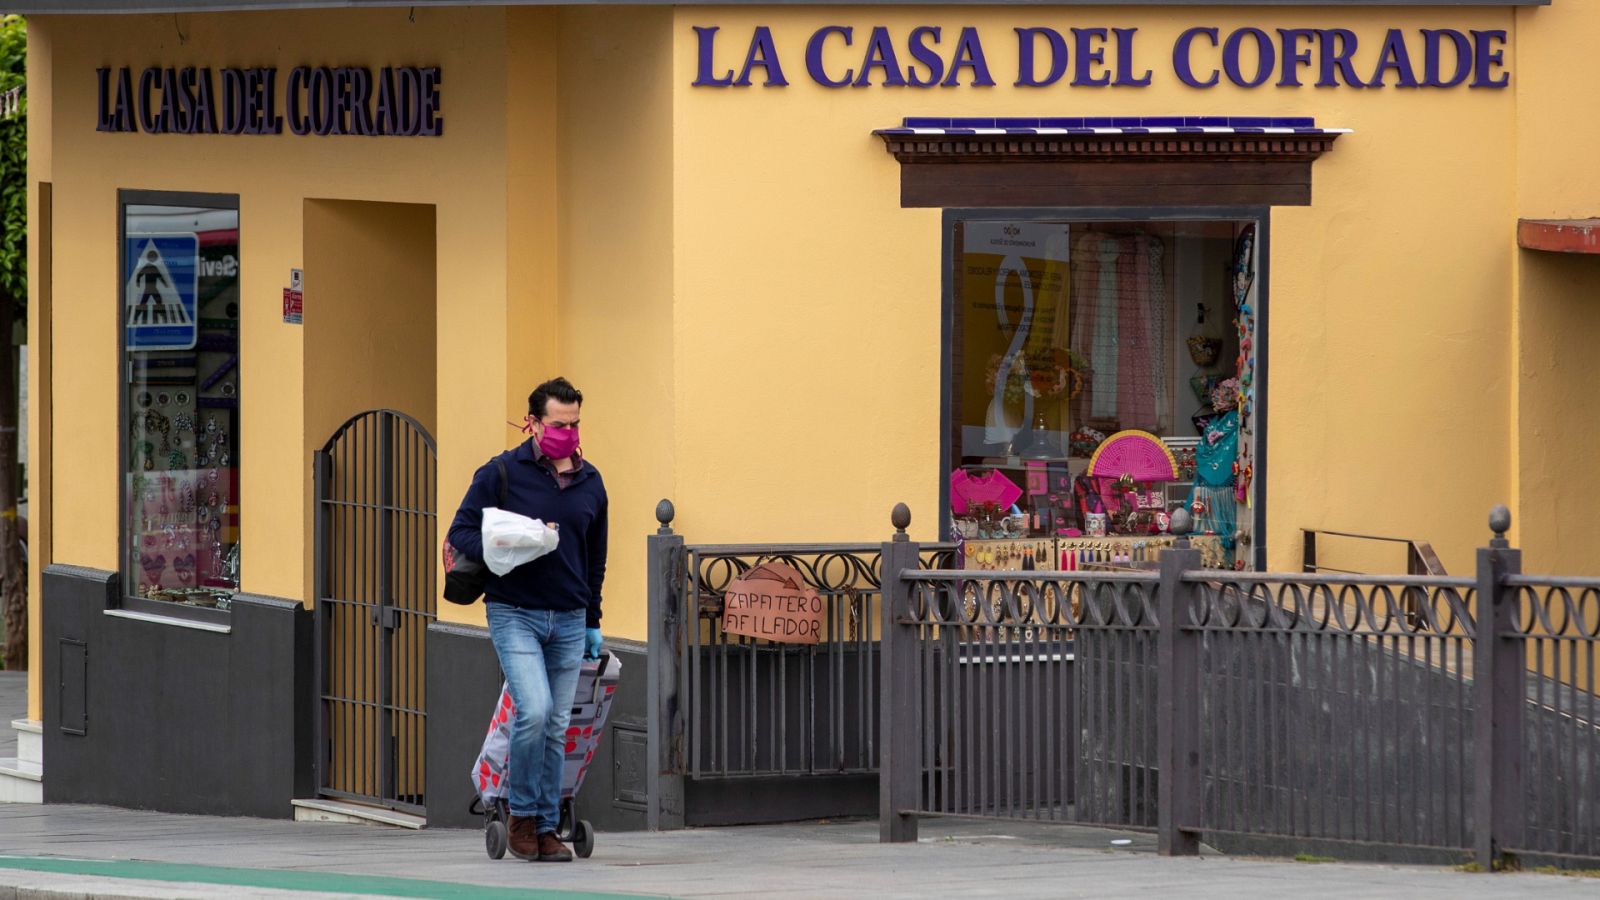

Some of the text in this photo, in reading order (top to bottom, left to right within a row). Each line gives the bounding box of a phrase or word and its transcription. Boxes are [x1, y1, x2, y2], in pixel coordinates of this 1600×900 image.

[691, 25, 1510, 89] LA CASA DEL COFRADE
[96, 66, 443, 136] LA CASA DEL COFRADE
[727, 591, 822, 613] ZAPATERO
[726, 614, 820, 638] AFILADOR
